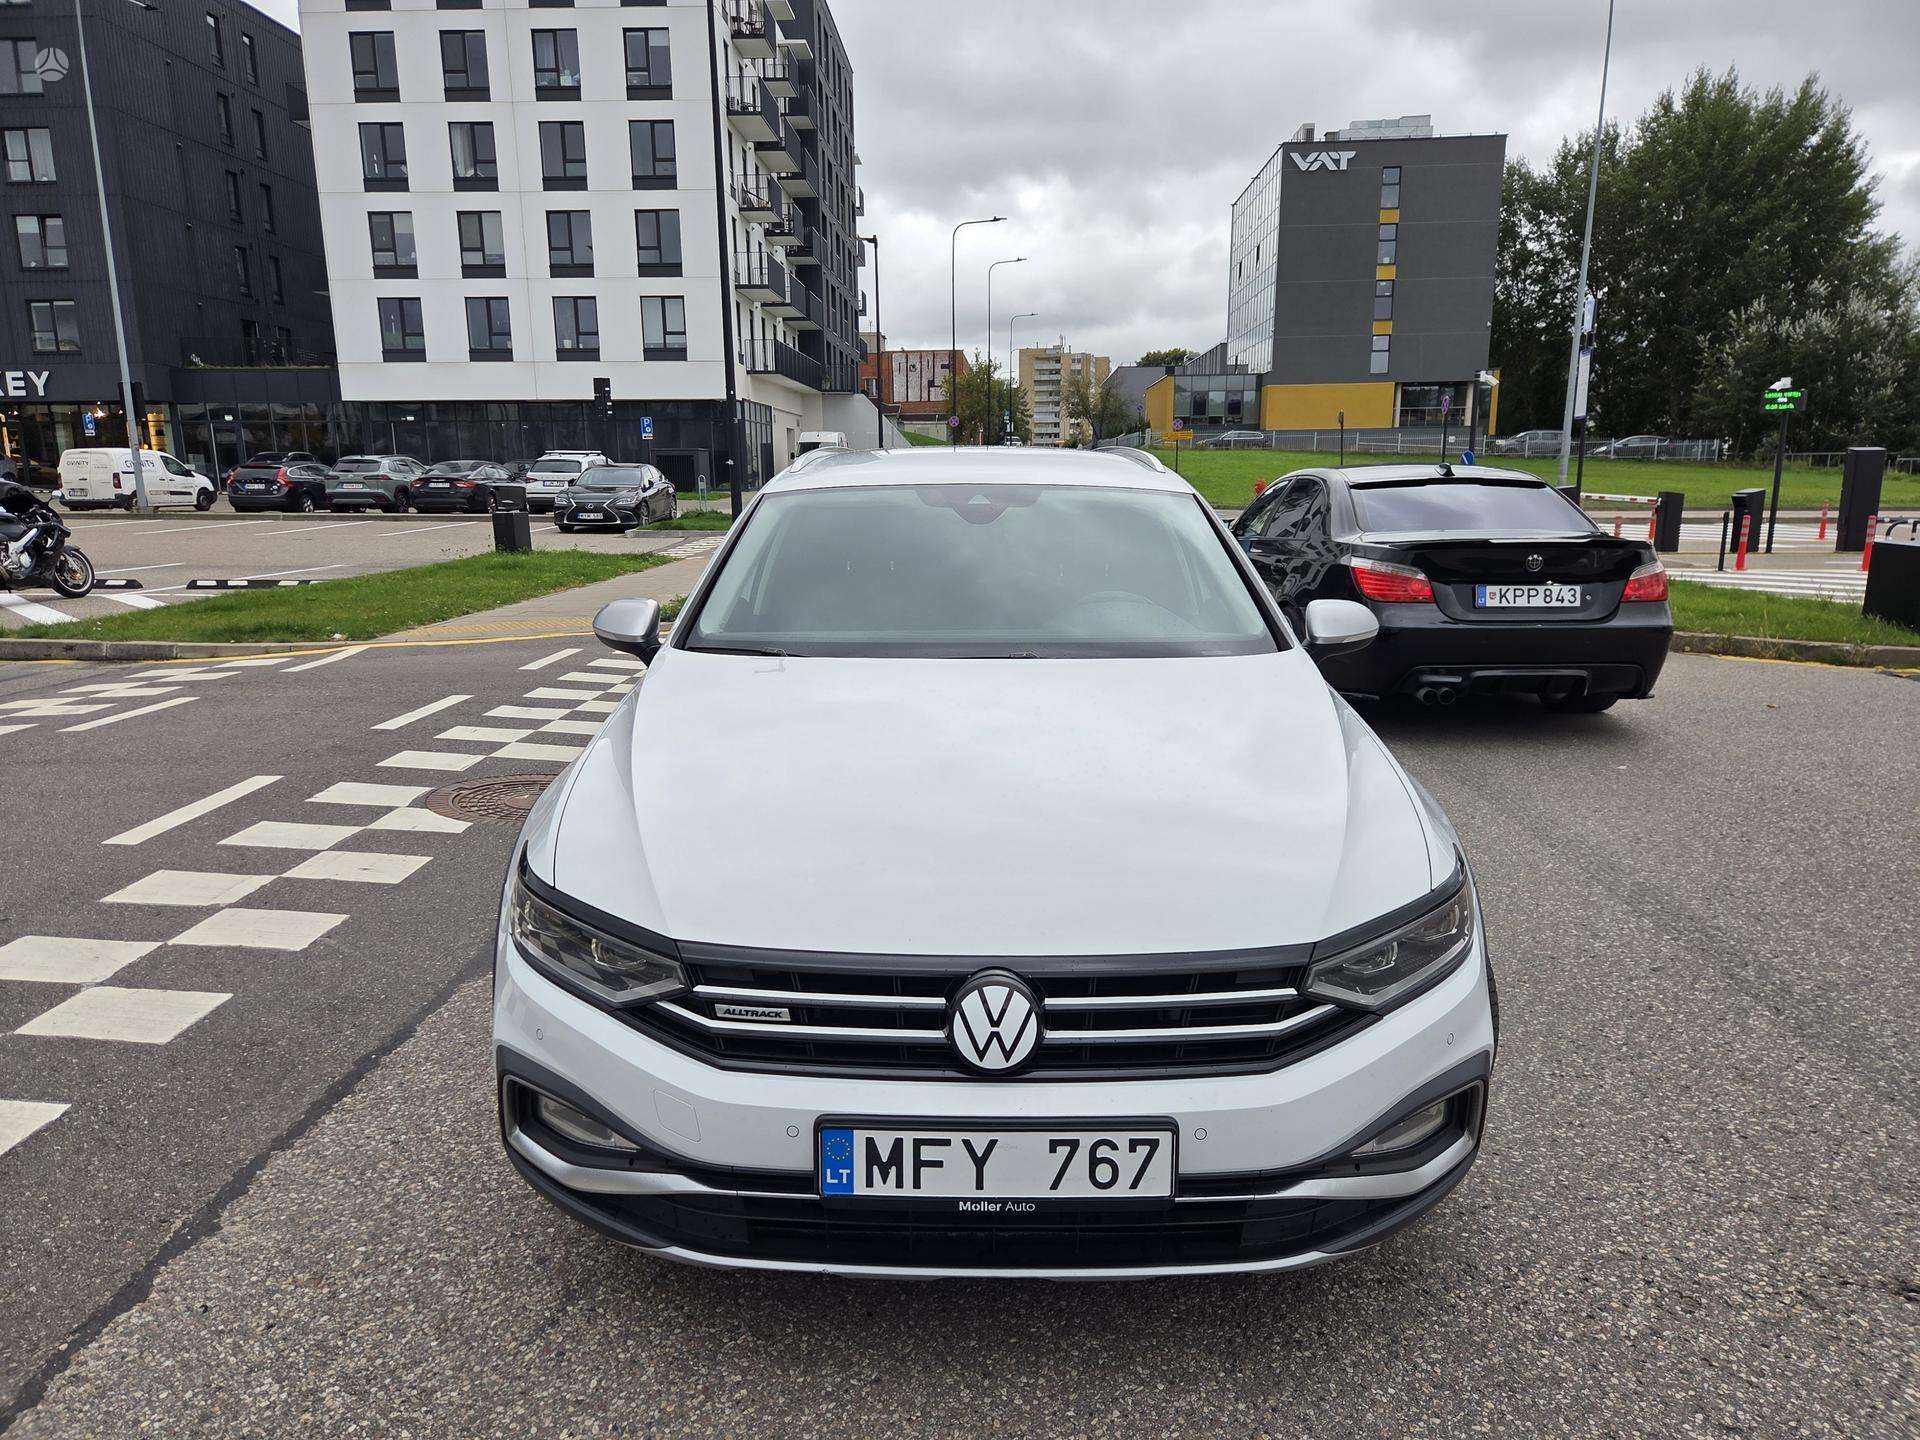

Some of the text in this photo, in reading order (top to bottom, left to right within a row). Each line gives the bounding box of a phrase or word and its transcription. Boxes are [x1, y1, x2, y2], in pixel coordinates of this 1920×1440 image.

[1289, 150, 1357, 171] VAT
[1498, 588, 1577, 604] KPP 843
[723, 1007, 783, 1019] ALLTRACK
[865, 1136, 1161, 1191] MFY 767
[826, 1168, 850, 1184] LT
[958, 1201, 1036, 1212] Moller Auto
